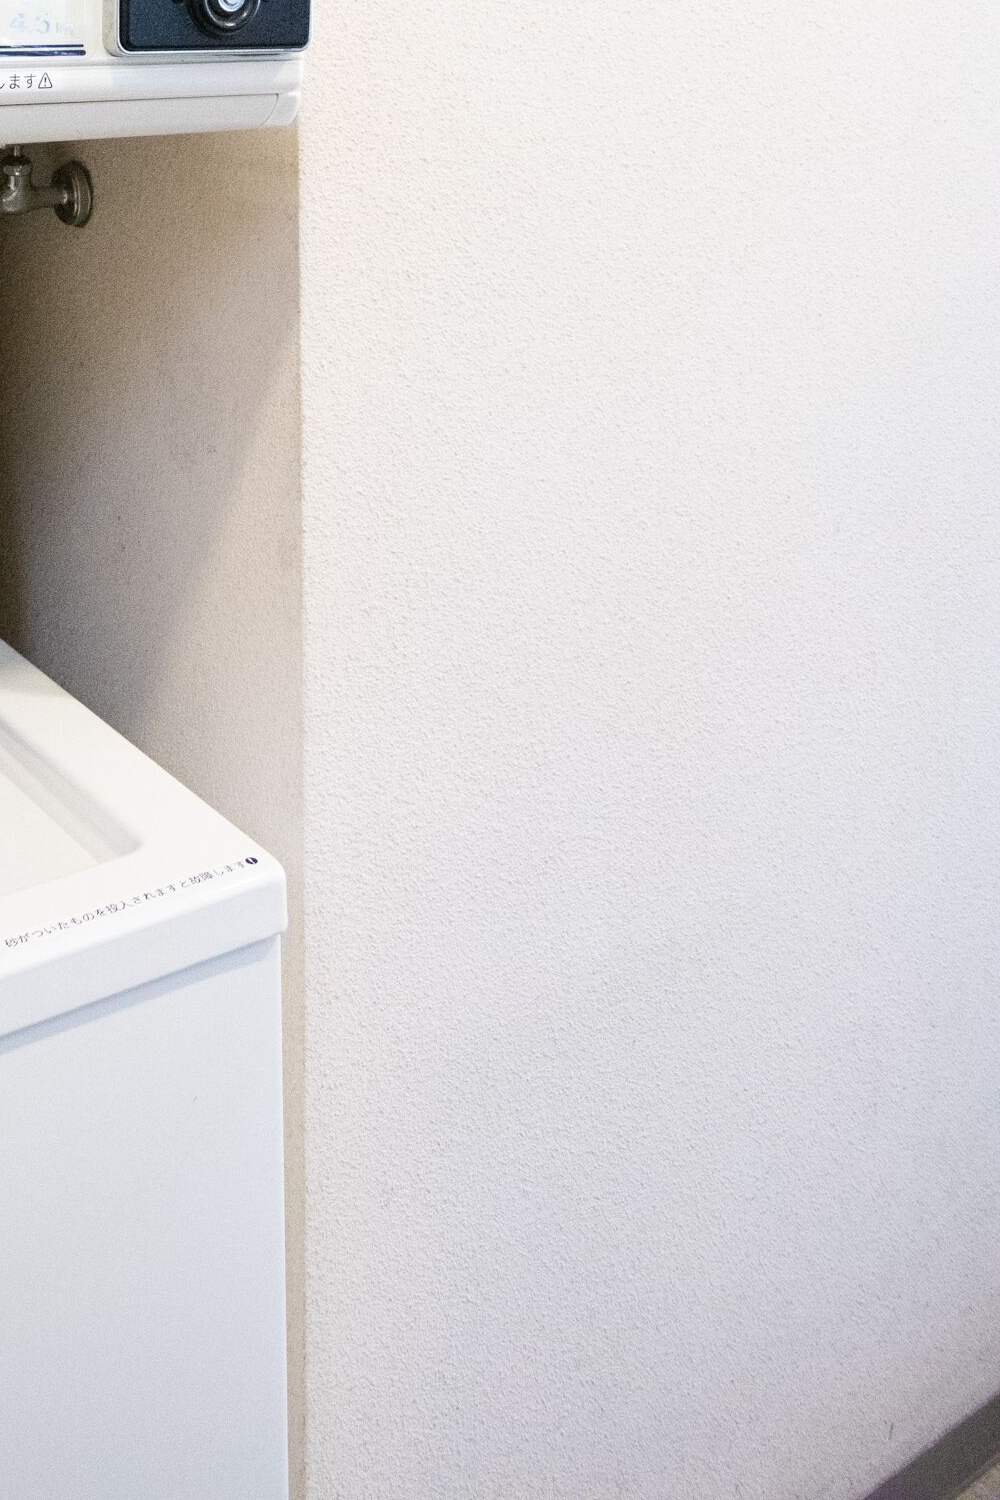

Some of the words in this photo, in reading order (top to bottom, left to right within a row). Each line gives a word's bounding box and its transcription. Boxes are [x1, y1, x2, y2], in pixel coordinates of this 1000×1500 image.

[5, 860, 244, 948] 砂がついたものを投入されますと故障します
